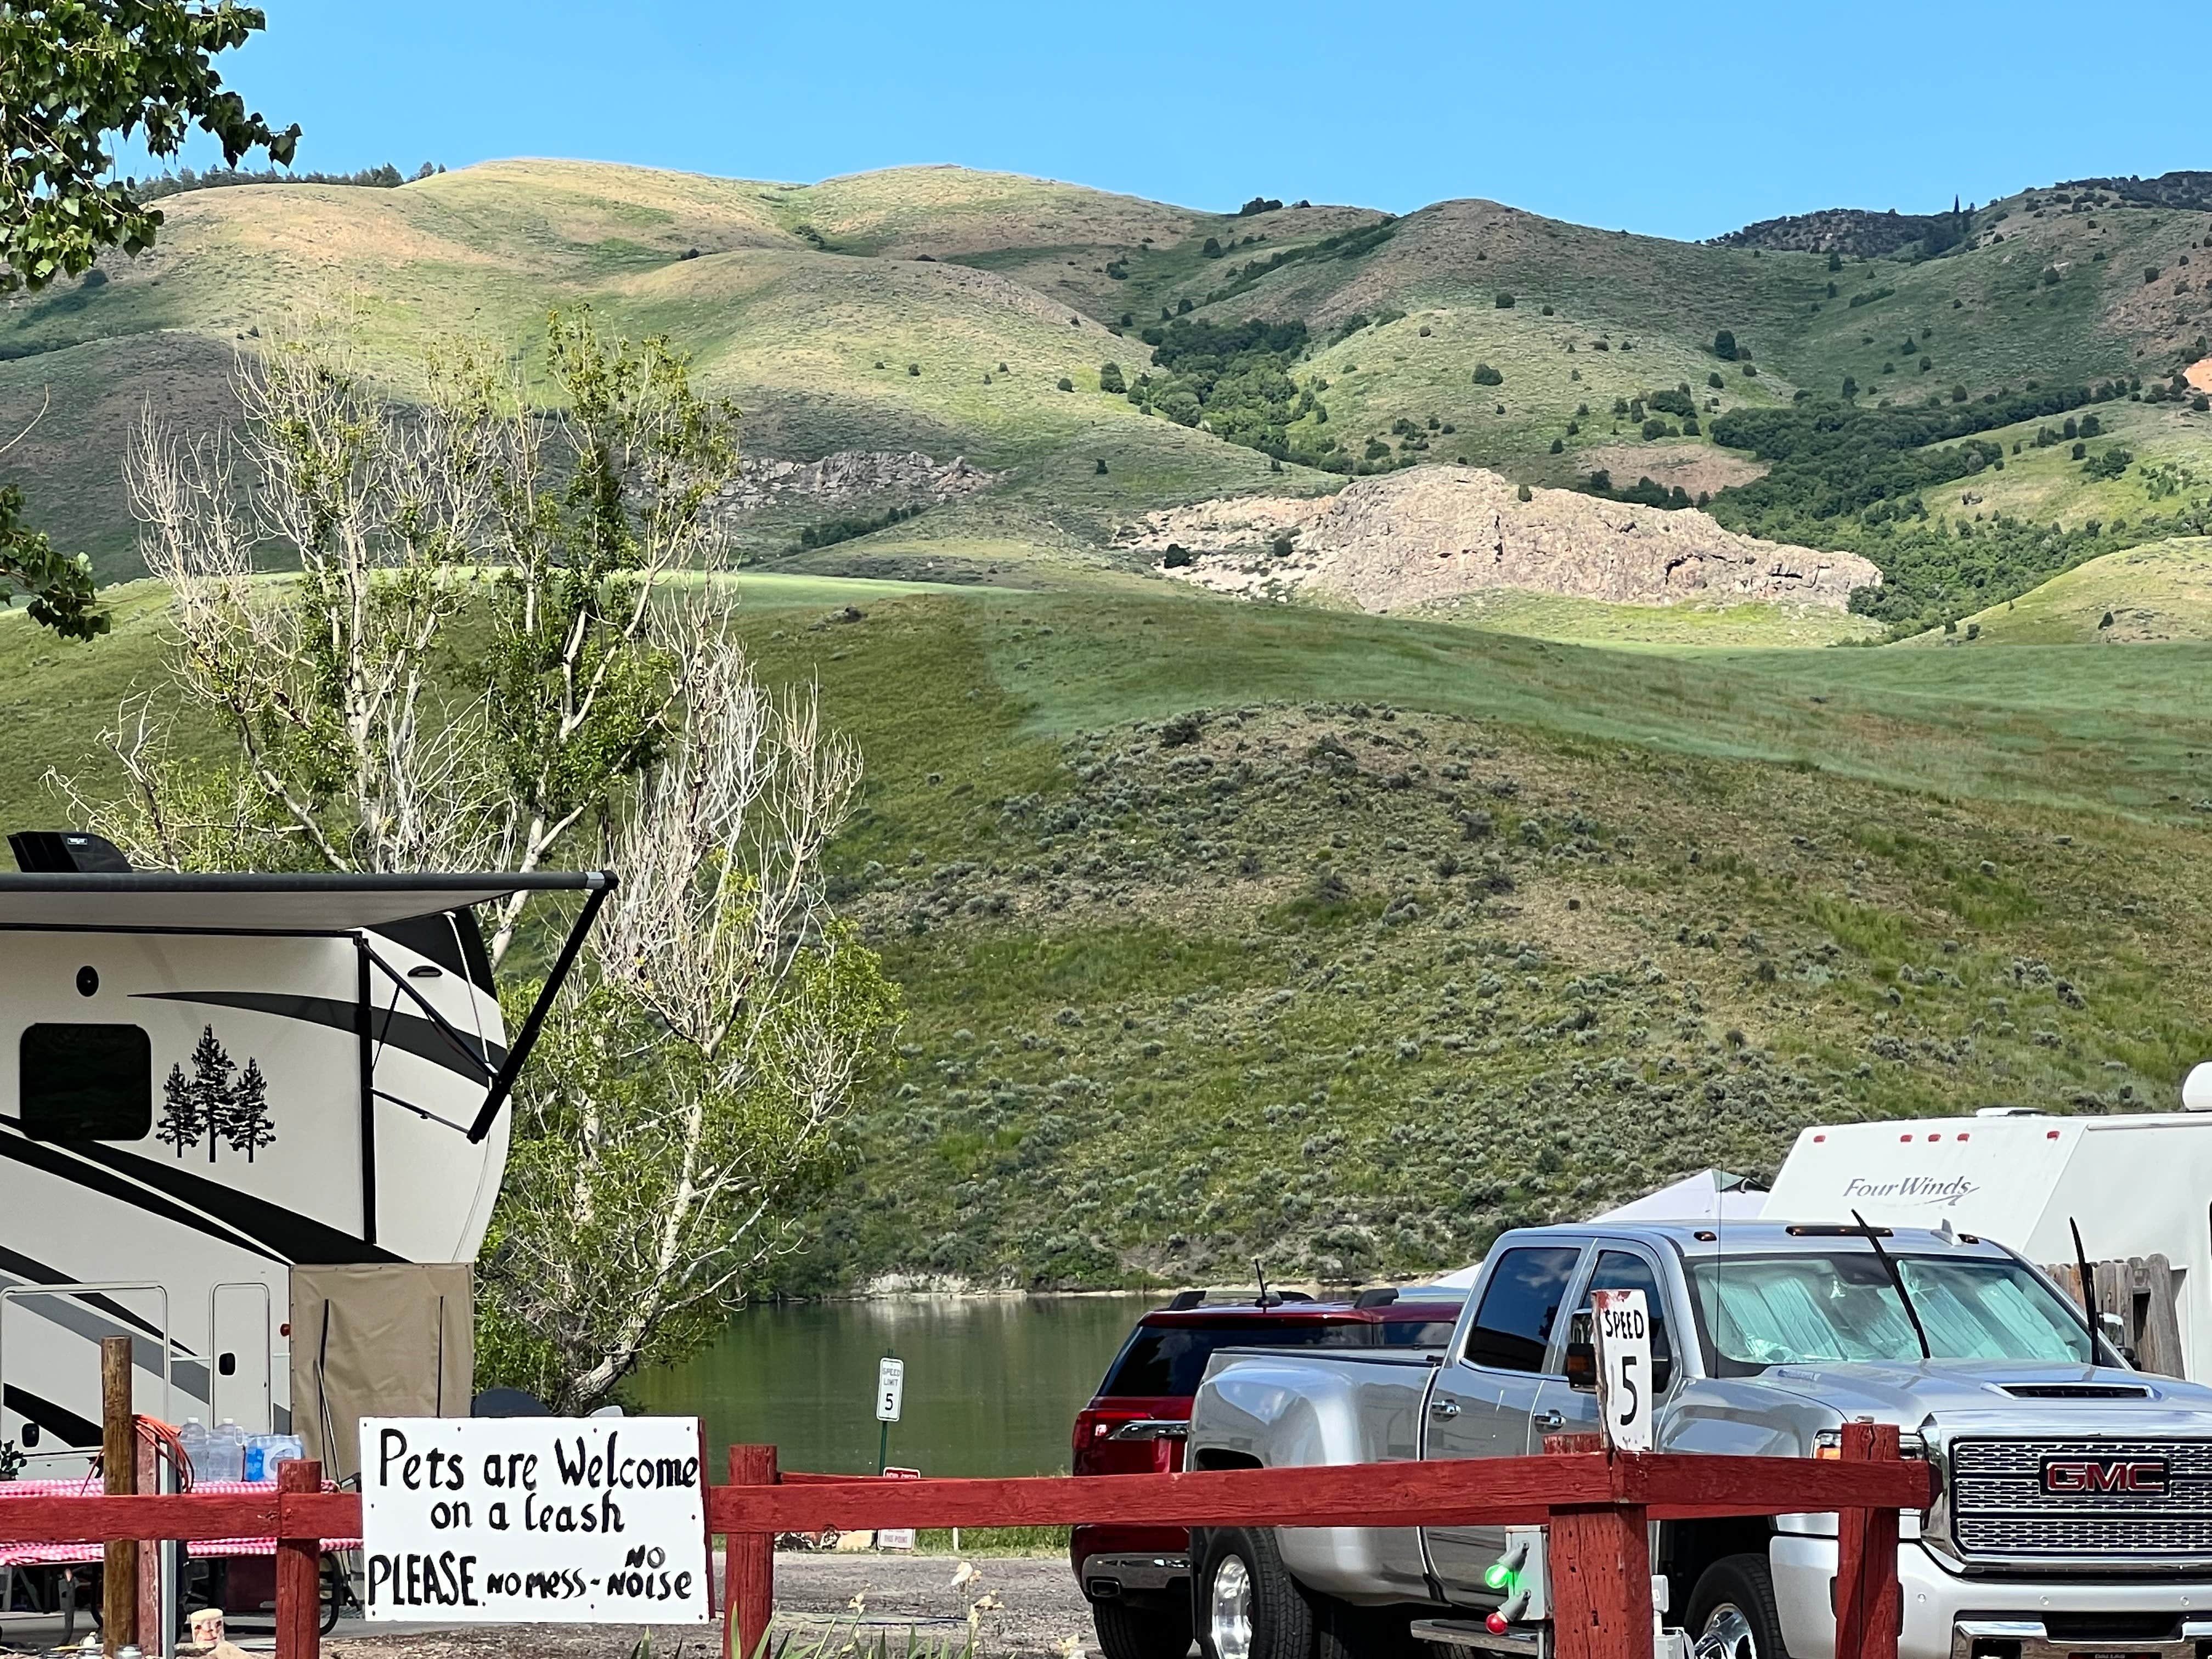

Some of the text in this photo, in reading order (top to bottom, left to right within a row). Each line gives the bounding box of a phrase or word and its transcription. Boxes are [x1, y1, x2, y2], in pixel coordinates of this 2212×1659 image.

[1604, 1309, 1644, 1339] SPEED
[882, 1368, 901, 1376] SPEED
[883, 1378, 899, 1386] LIMIT
[884, 1393, 893, 1410] 5
[1620, 1356, 1638, 1426] 5
[380, 1428, 698, 1492] Pets are Welcome
[2047, 1462, 2164, 1492] GMC
[431, 1489, 625, 1533] on a leash
[624, 1544, 665, 1569] NO
[368, 1550, 478, 1606] PLEASE
